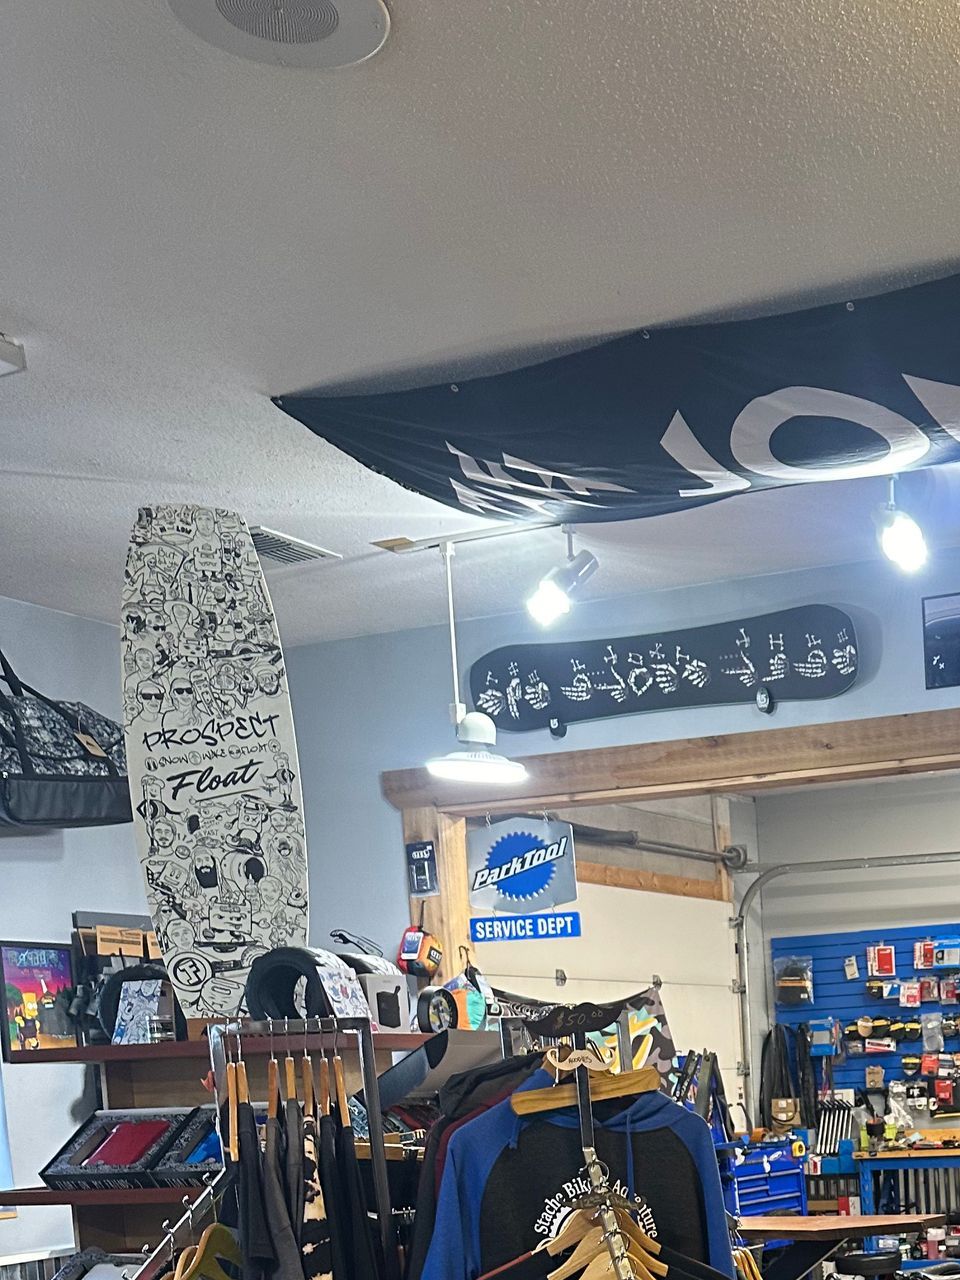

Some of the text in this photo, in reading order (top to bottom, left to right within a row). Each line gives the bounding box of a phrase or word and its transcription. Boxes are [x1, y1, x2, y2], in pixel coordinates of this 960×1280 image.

[142, 711, 280, 752] PROSPECT
[158, 753, 189, 768] SNOW
[166, 758, 264, 800] Float
[475, 916, 574, 939] SERVICE DEPT
[534, 1192, 565, 1235] Stache
[562, 1177, 592, 1199] Bik
